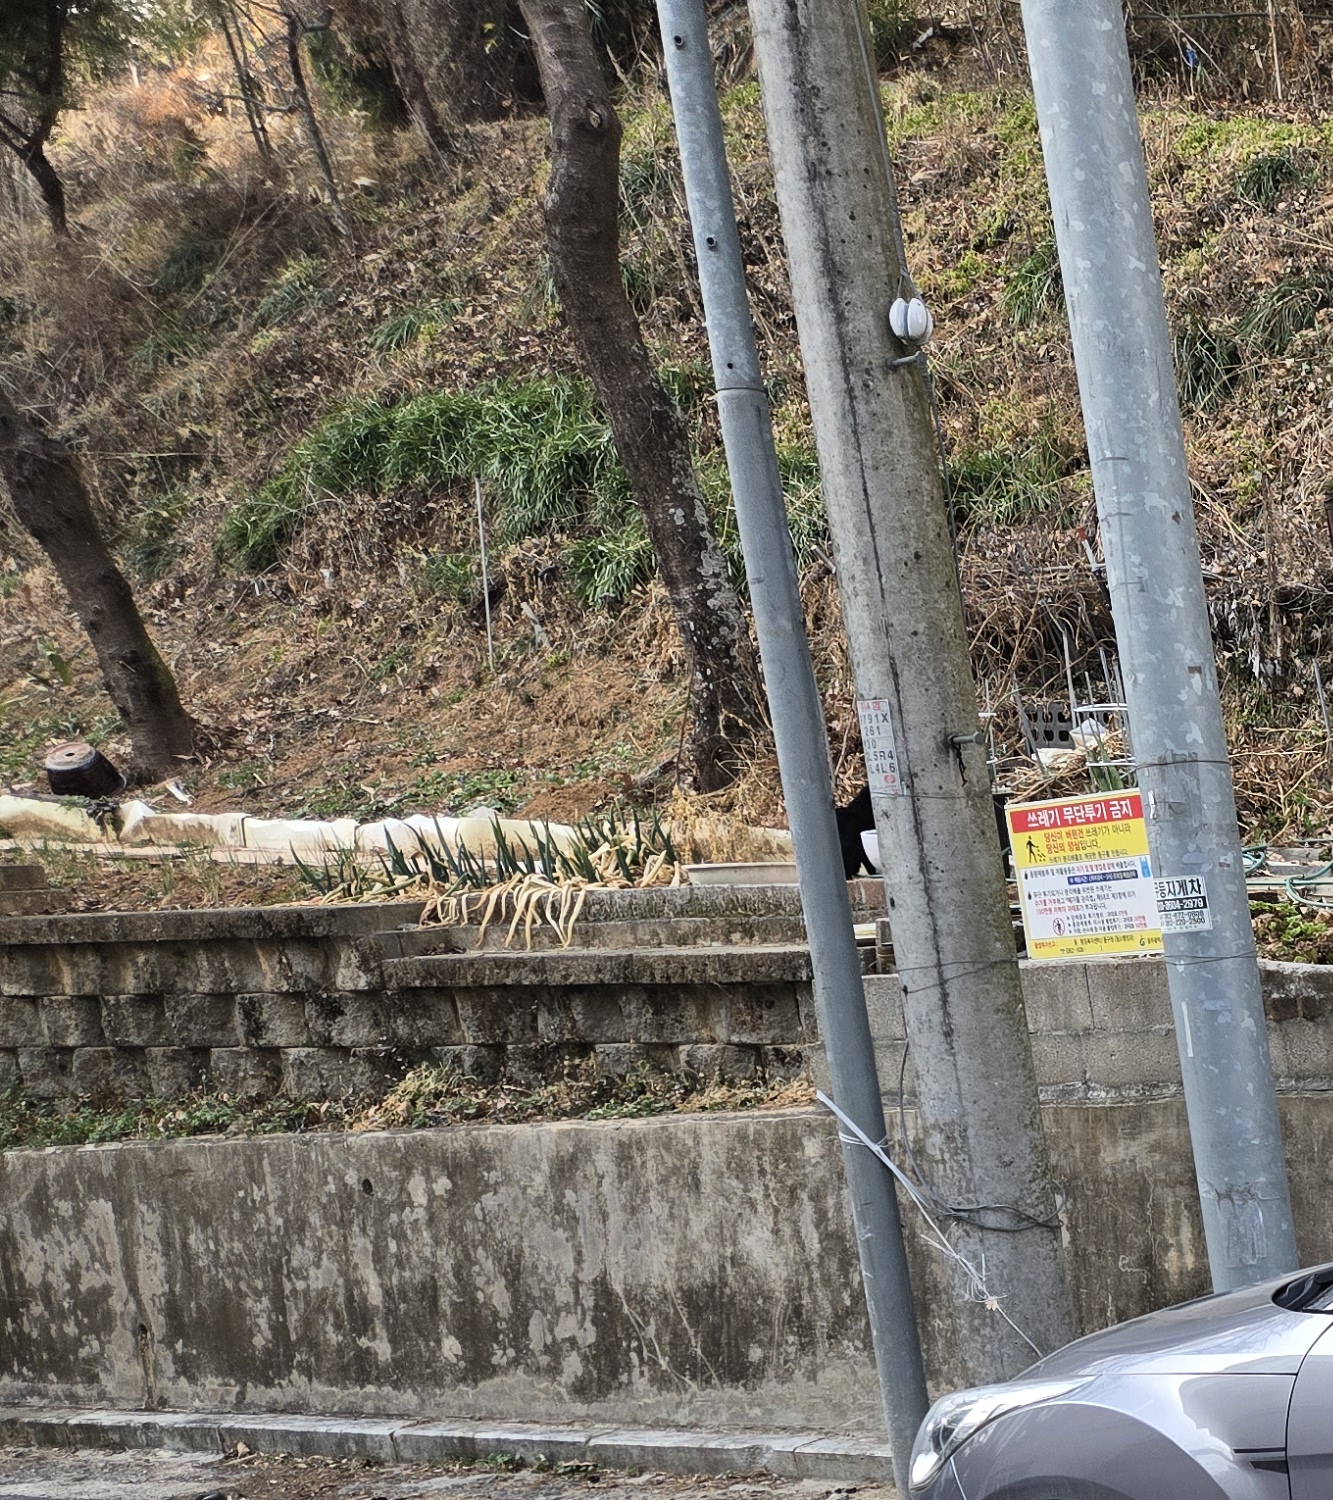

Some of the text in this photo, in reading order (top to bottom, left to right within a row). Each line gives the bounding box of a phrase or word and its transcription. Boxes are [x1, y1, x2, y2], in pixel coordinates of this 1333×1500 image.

[1026, 799, 1133, 828] 쓰레기 무단투기 금지
[1043, 830, 1064, 843] 당신이
[1085, 826, 1110, 838] 쓰레기가
[1112, 823, 1131, 834] 아니라
[1046, 843, 1066, 854] 당신의
